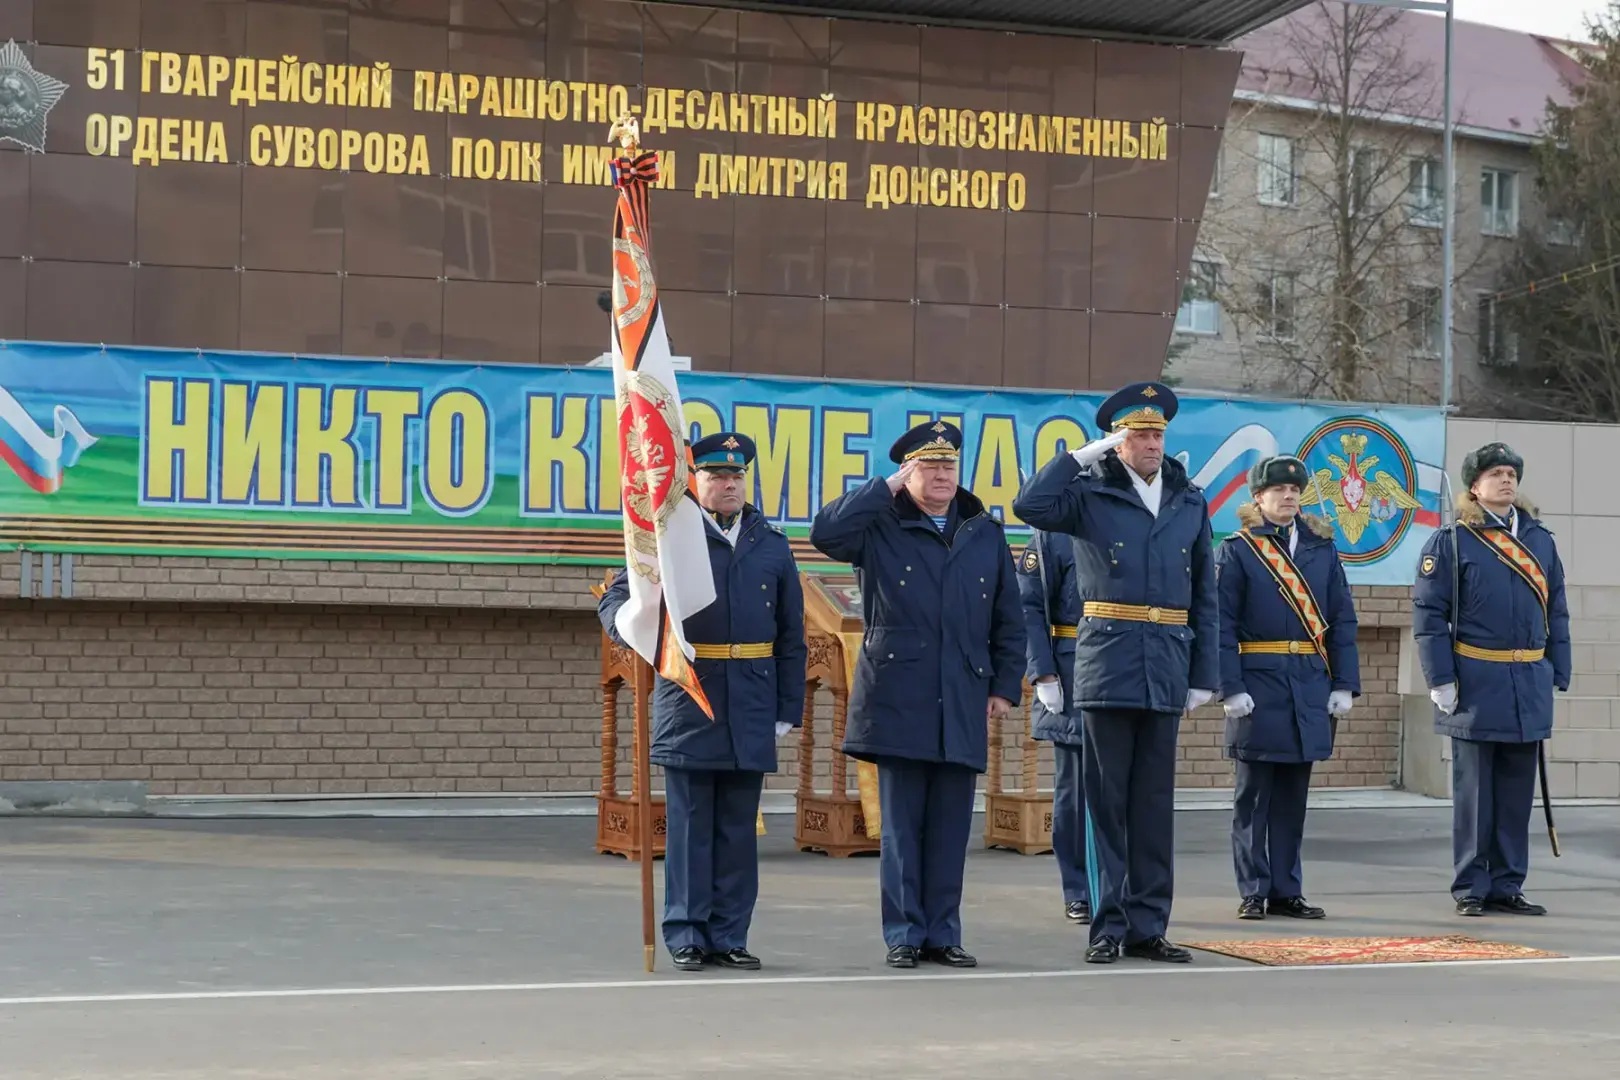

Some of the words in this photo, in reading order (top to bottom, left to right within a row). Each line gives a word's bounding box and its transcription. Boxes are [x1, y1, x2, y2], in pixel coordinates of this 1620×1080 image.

[87, 47, 125, 91] 51
[140, 49, 393, 109] ГВАРДЕЙСКИЙ
[855, 101, 1168, 161] КРАСНОЗНАМЕННЫЙ
[86, 113, 229, 167] ОРДЕНА
[249, 123, 431, 176] СУВОРОВА
[450, 136, 542, 183] ПОЛК
[562, 143, 676, 190] ИМИ
[694, 152, 848, 201] ДМИТРИЯ
[865, 163, 1027, 212] ДОНСКОГО
[142, 374, 493, 513] НИКТО
